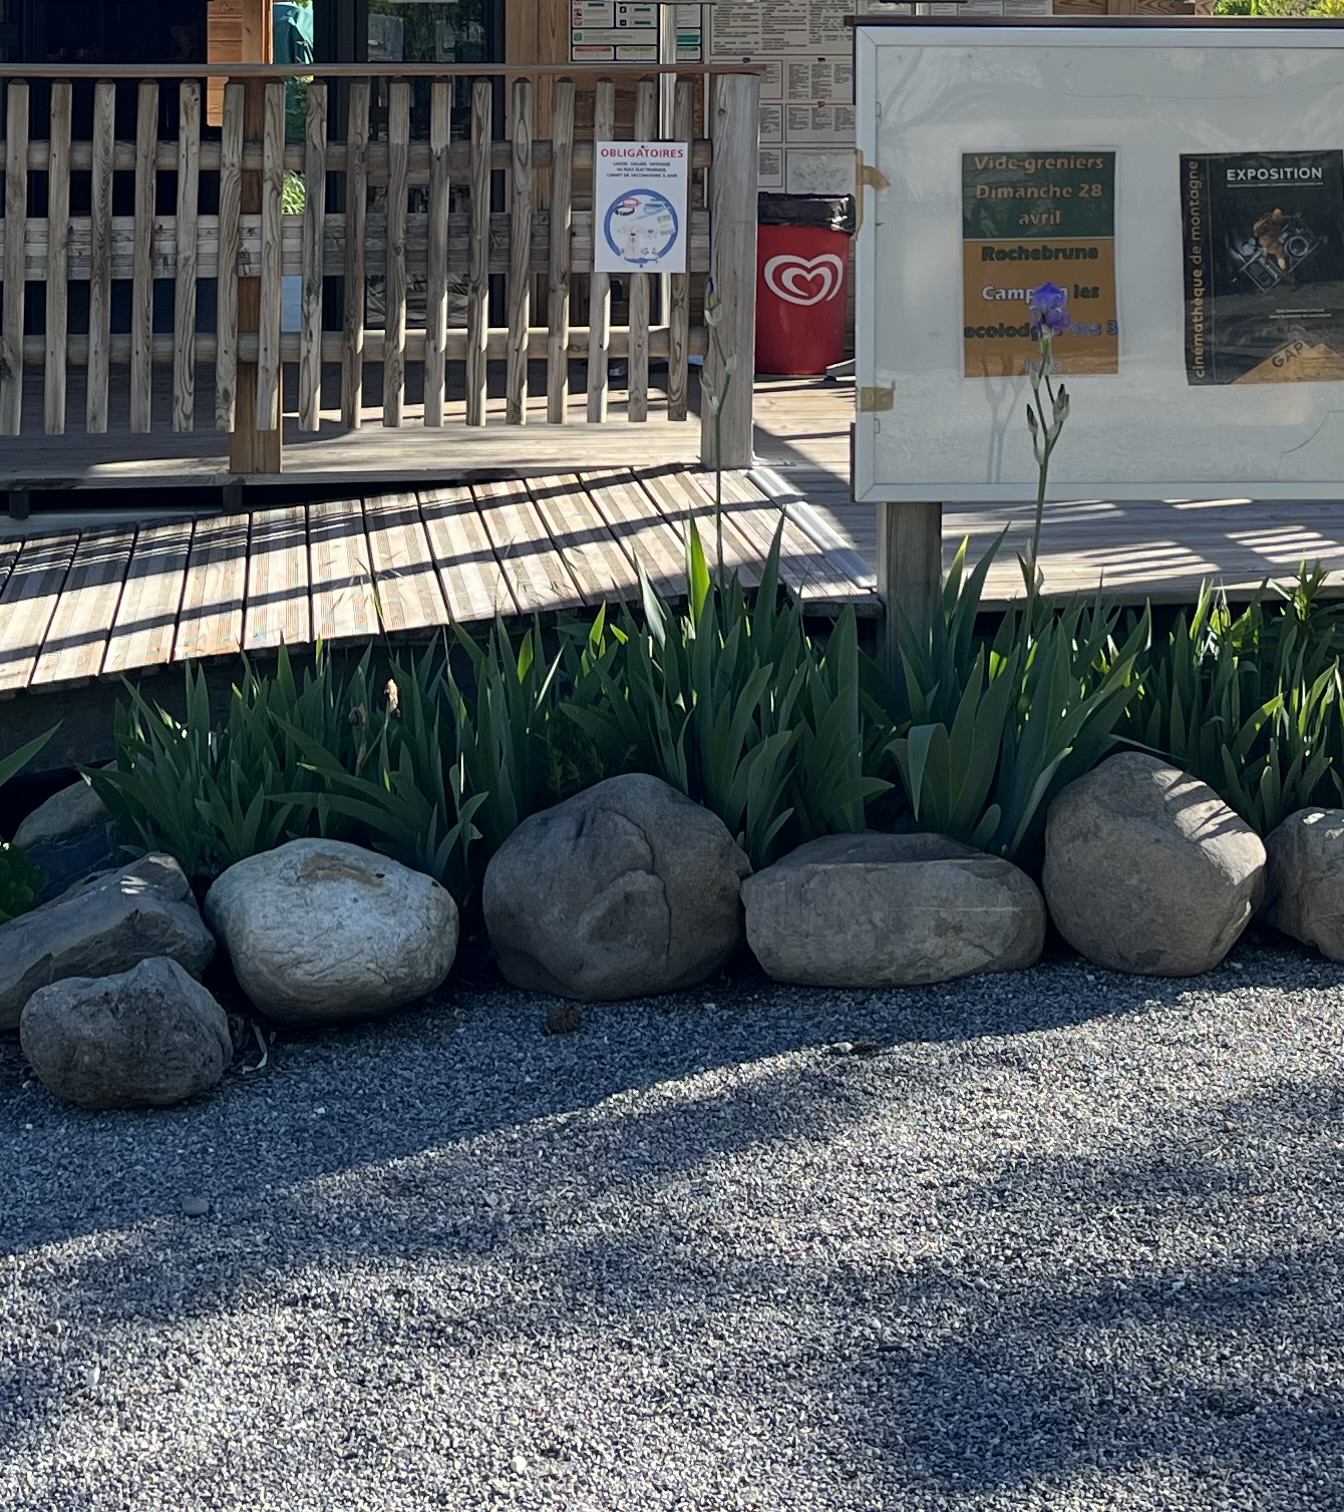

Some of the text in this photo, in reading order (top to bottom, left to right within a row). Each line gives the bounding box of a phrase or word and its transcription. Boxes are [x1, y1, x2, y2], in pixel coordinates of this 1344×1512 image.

[600, 148, 684, 159] OBLIGATOIRES
[974, 155, 1104, 174] Vide-greniers
[1226, 167, 1323, 181] EXPOSITION
[976, 183, 1104, 199] Dimanche 28
[1018, 210, 1061, 225] avril
[981, 245, 1099, 262] Rochebrune
[1188, 160, 1206, 378] cinémathèque de montagne
[982, 284, 1100, 304] Camp les
[1271, 341, 1305, 368] GAP
